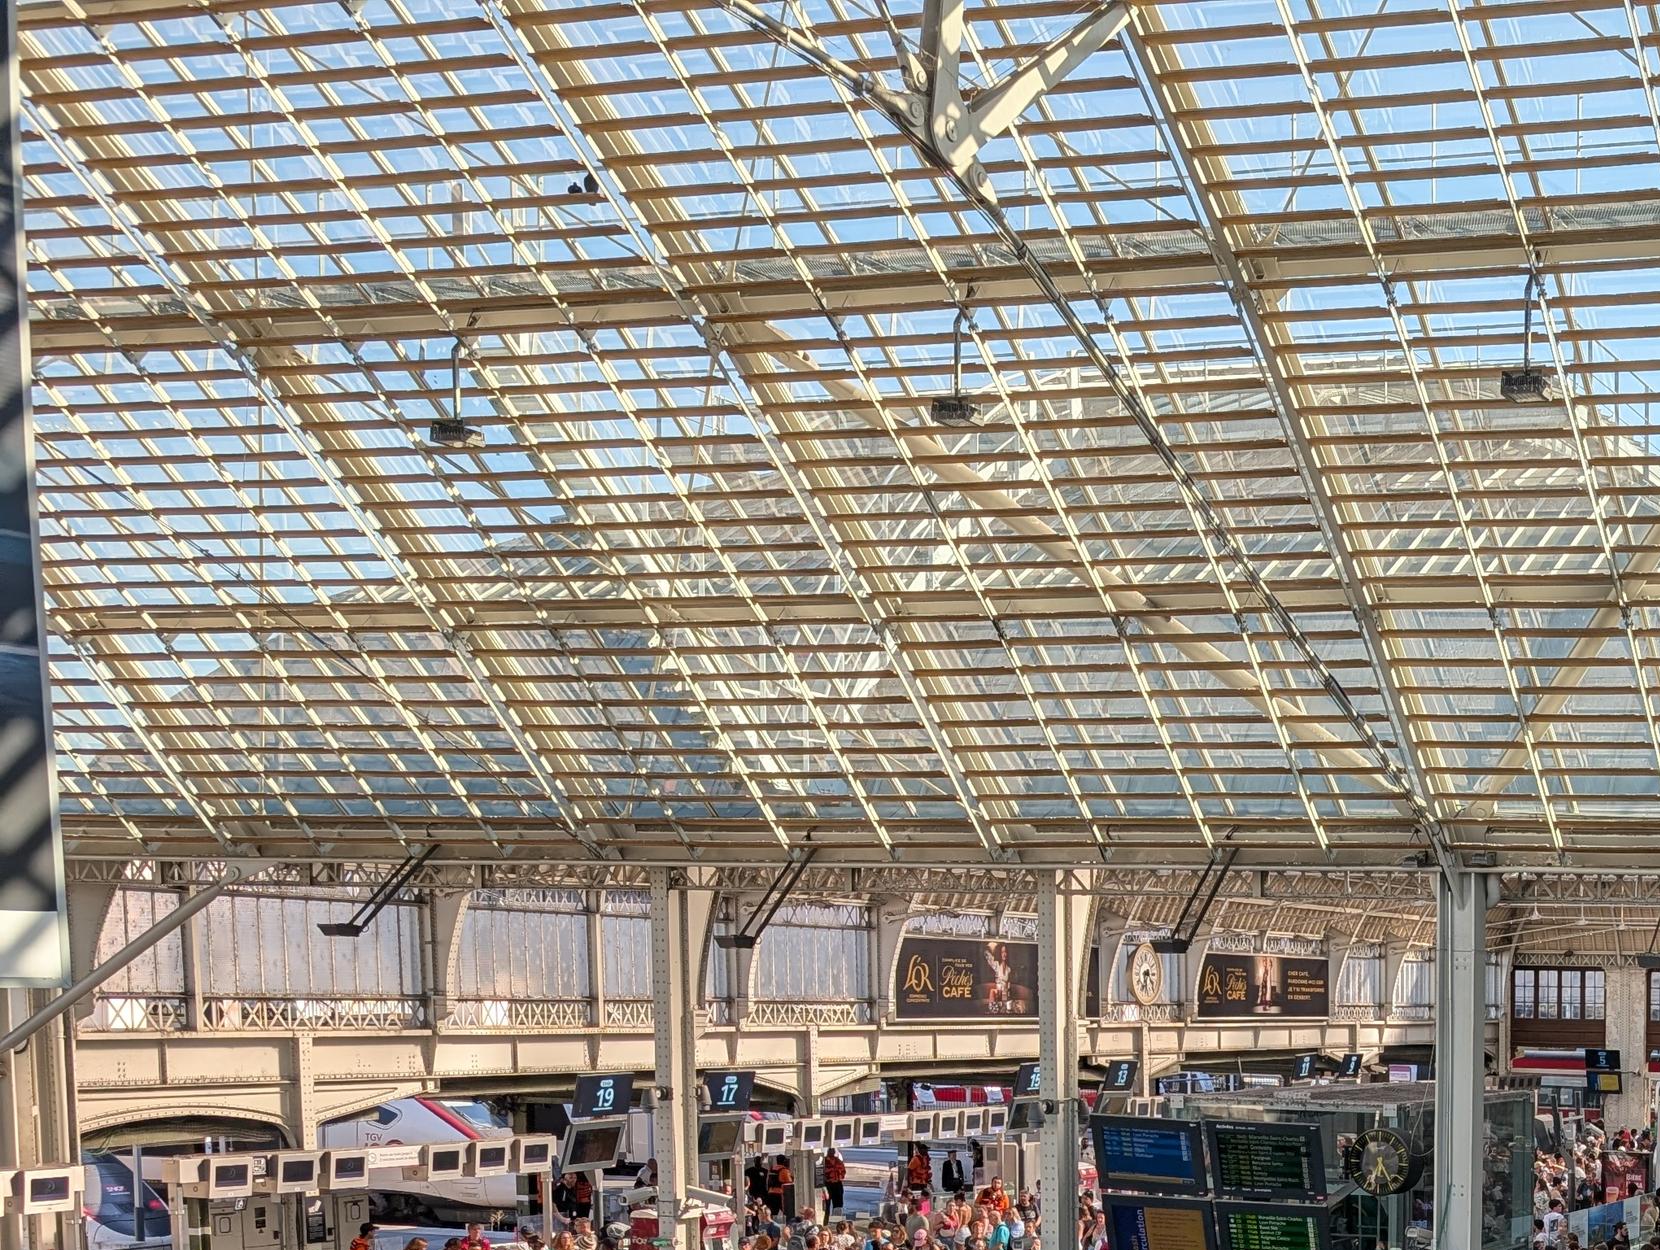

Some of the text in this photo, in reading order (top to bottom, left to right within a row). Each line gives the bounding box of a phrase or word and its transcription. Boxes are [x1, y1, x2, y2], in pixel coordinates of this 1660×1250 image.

[1116, 1069, 1128, 1084] 13
[596, 1088, 615, 1107] 19
[720, 1084, 739, 1102] 17
[365, 1133, 383, 1141] TGV
